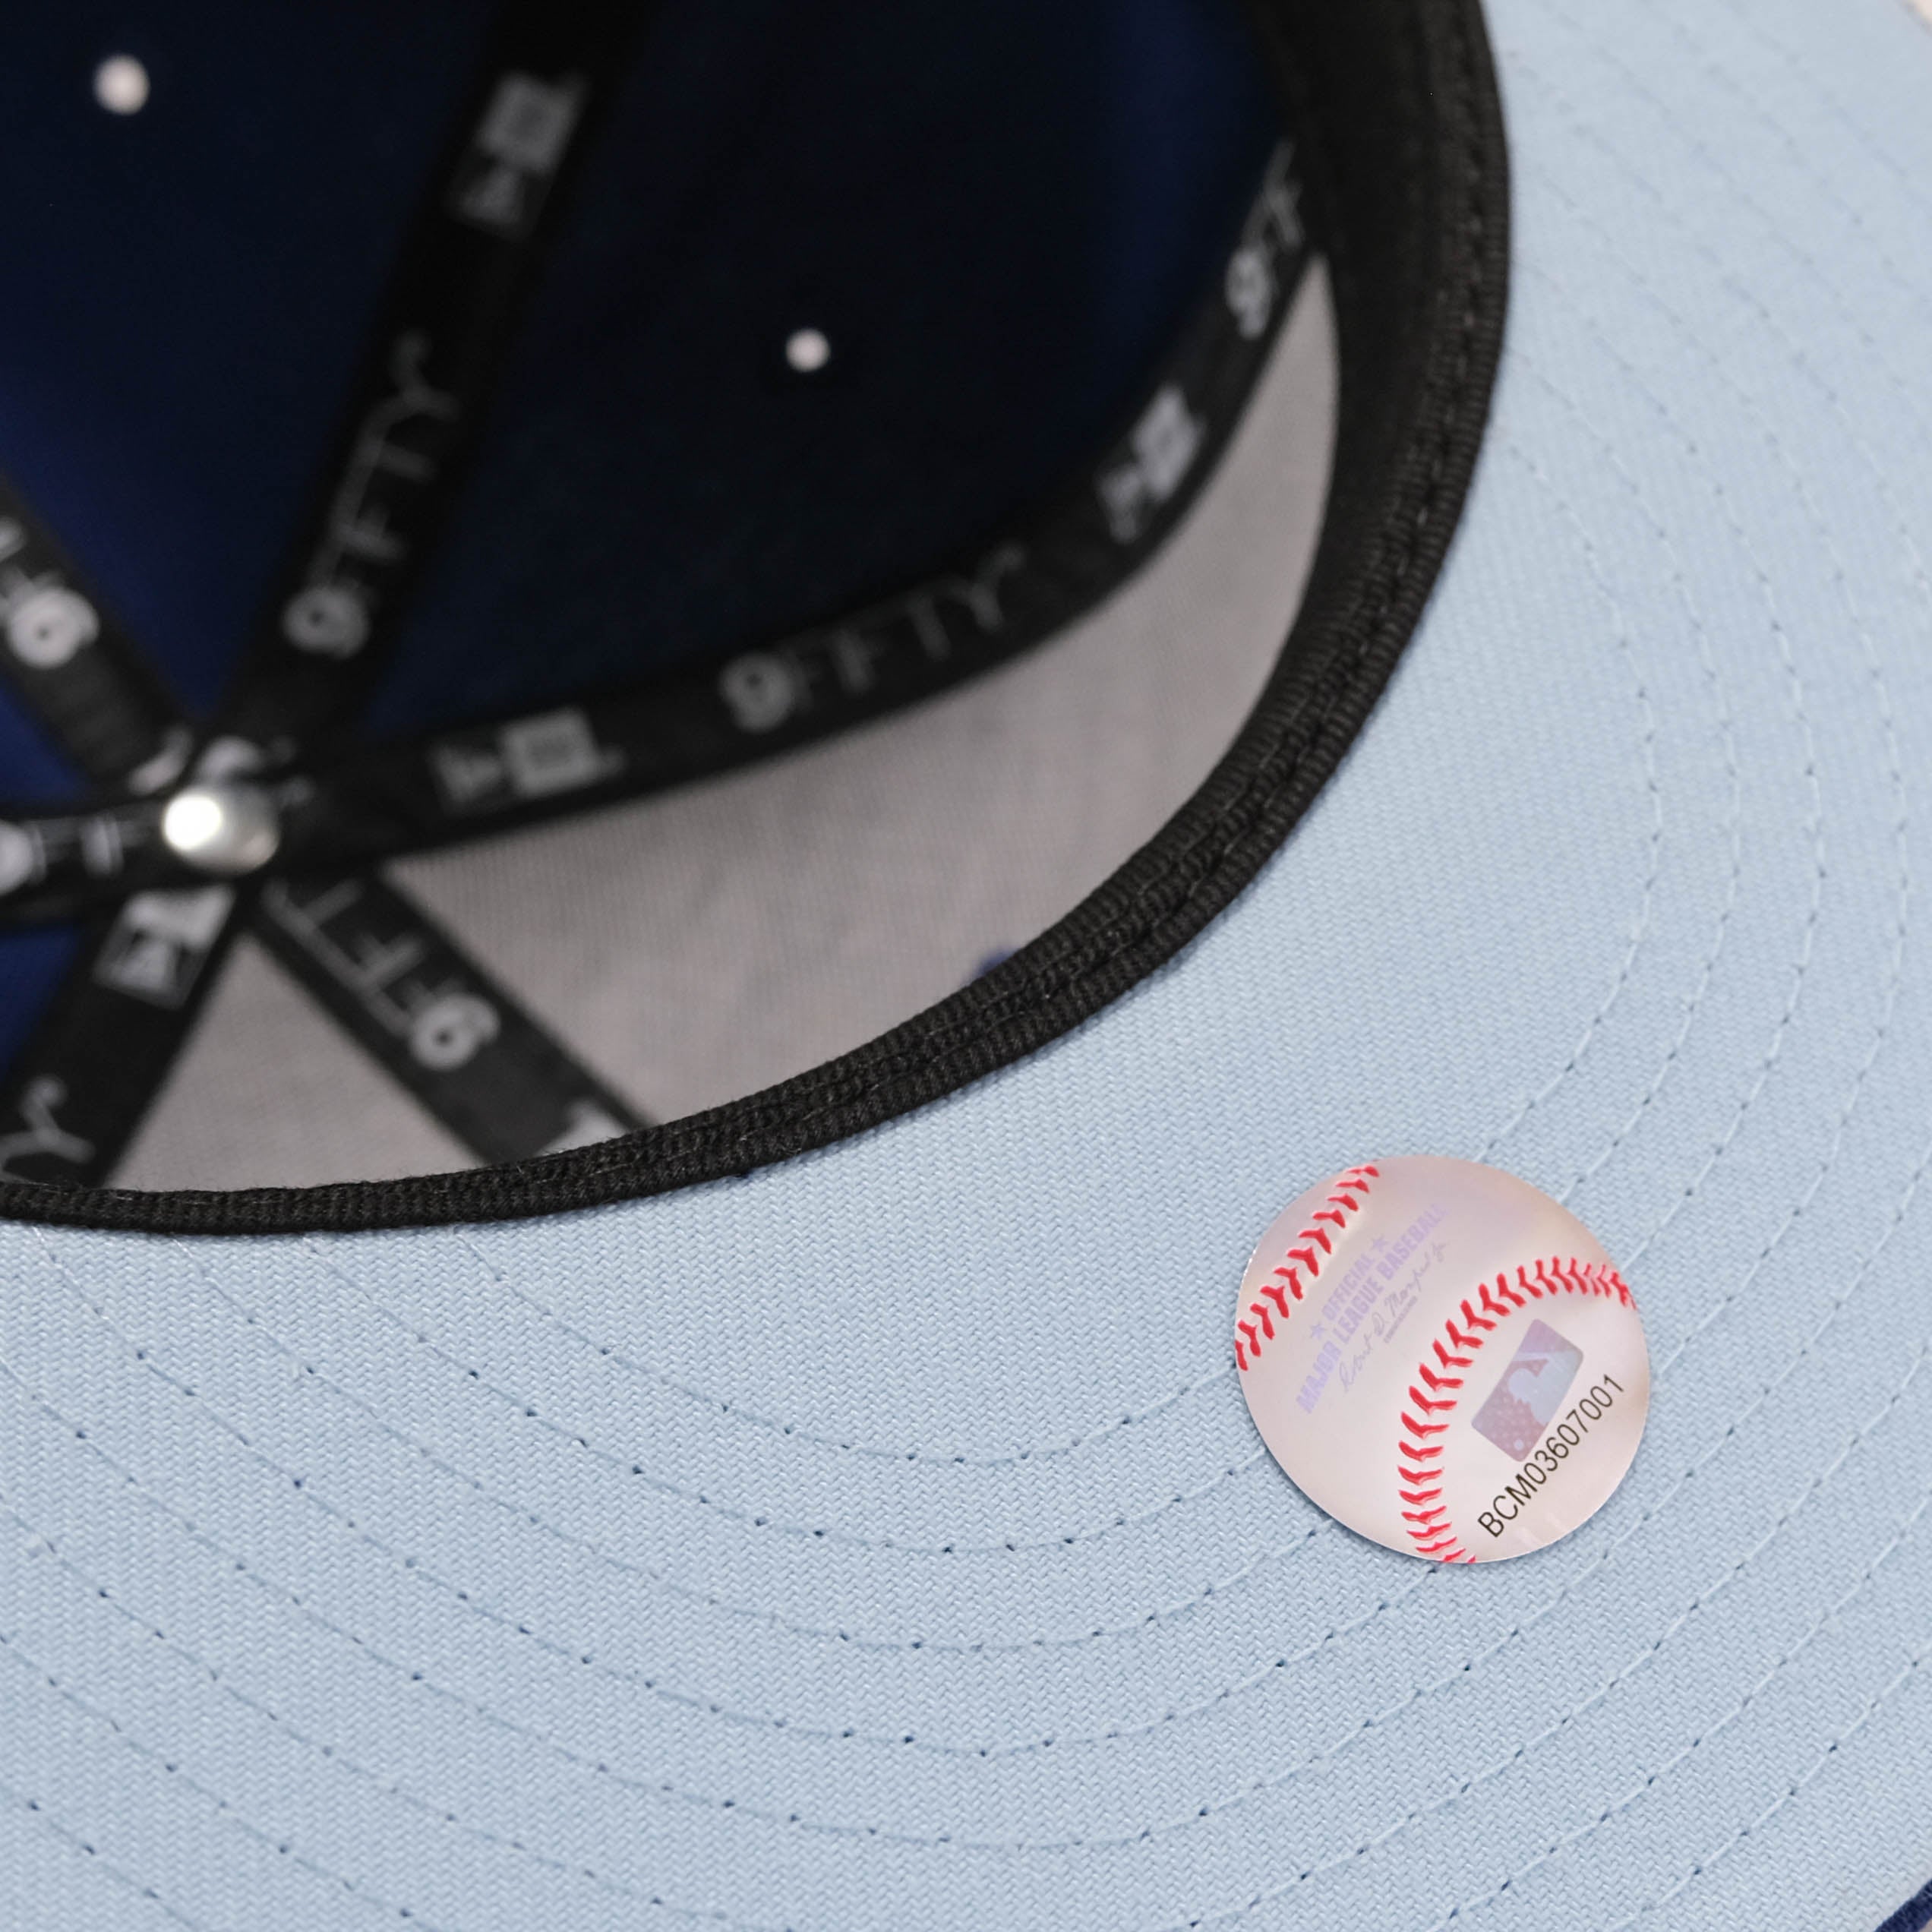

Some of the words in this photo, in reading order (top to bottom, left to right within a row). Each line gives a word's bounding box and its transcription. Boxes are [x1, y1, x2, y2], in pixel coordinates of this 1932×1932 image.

[1296, 1340, 1341, 1413] MAJOR
[1333, 1275, 1384, 1341] LEAGUE
[1378, 1204, 1447, 1281] BASEBALL
[1322, 1255, 1375, 1320] OFFICIAL
[1478, 1374, 1624, 1537] BCM03607001
